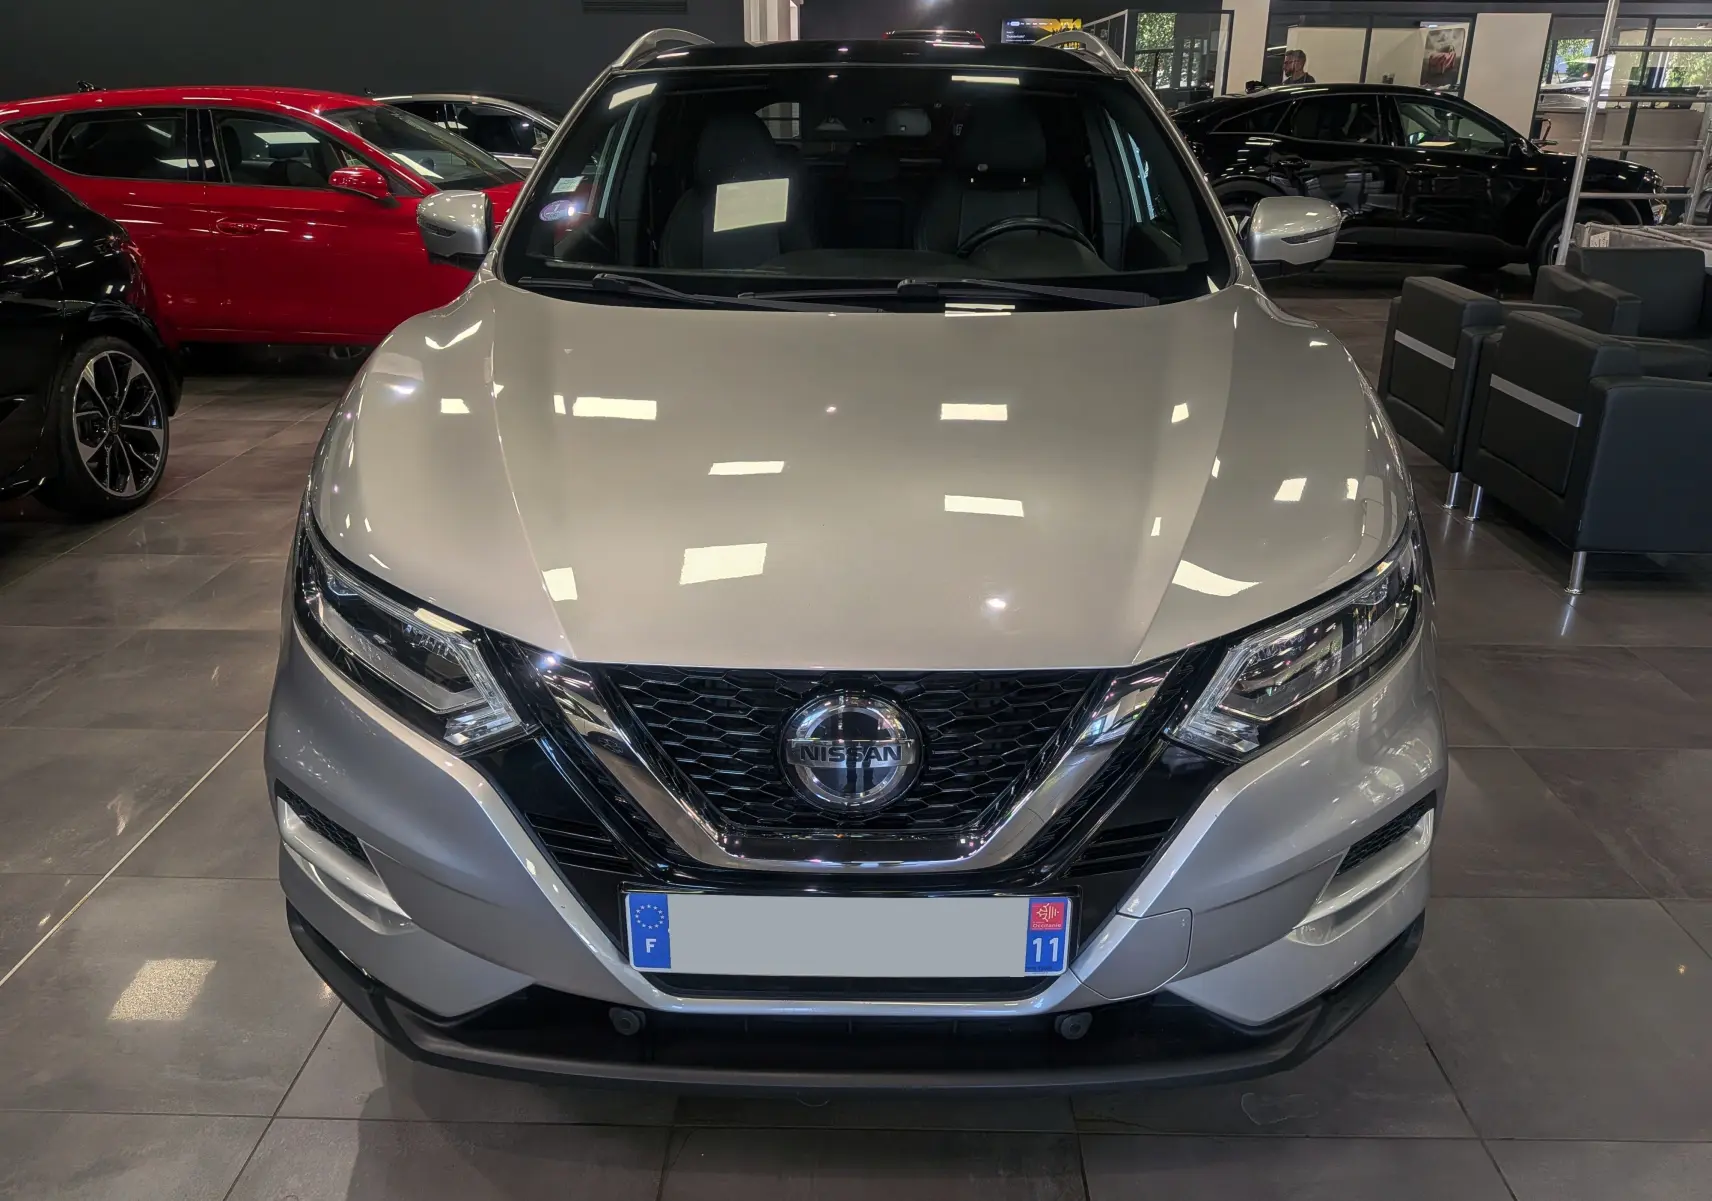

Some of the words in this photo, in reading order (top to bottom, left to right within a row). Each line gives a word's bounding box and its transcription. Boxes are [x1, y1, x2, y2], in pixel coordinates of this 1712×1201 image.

[800, 745, 902, 762] NISSAN
[645, 938, 657, 953] F
[1032, 937, 1059, 963] 11
